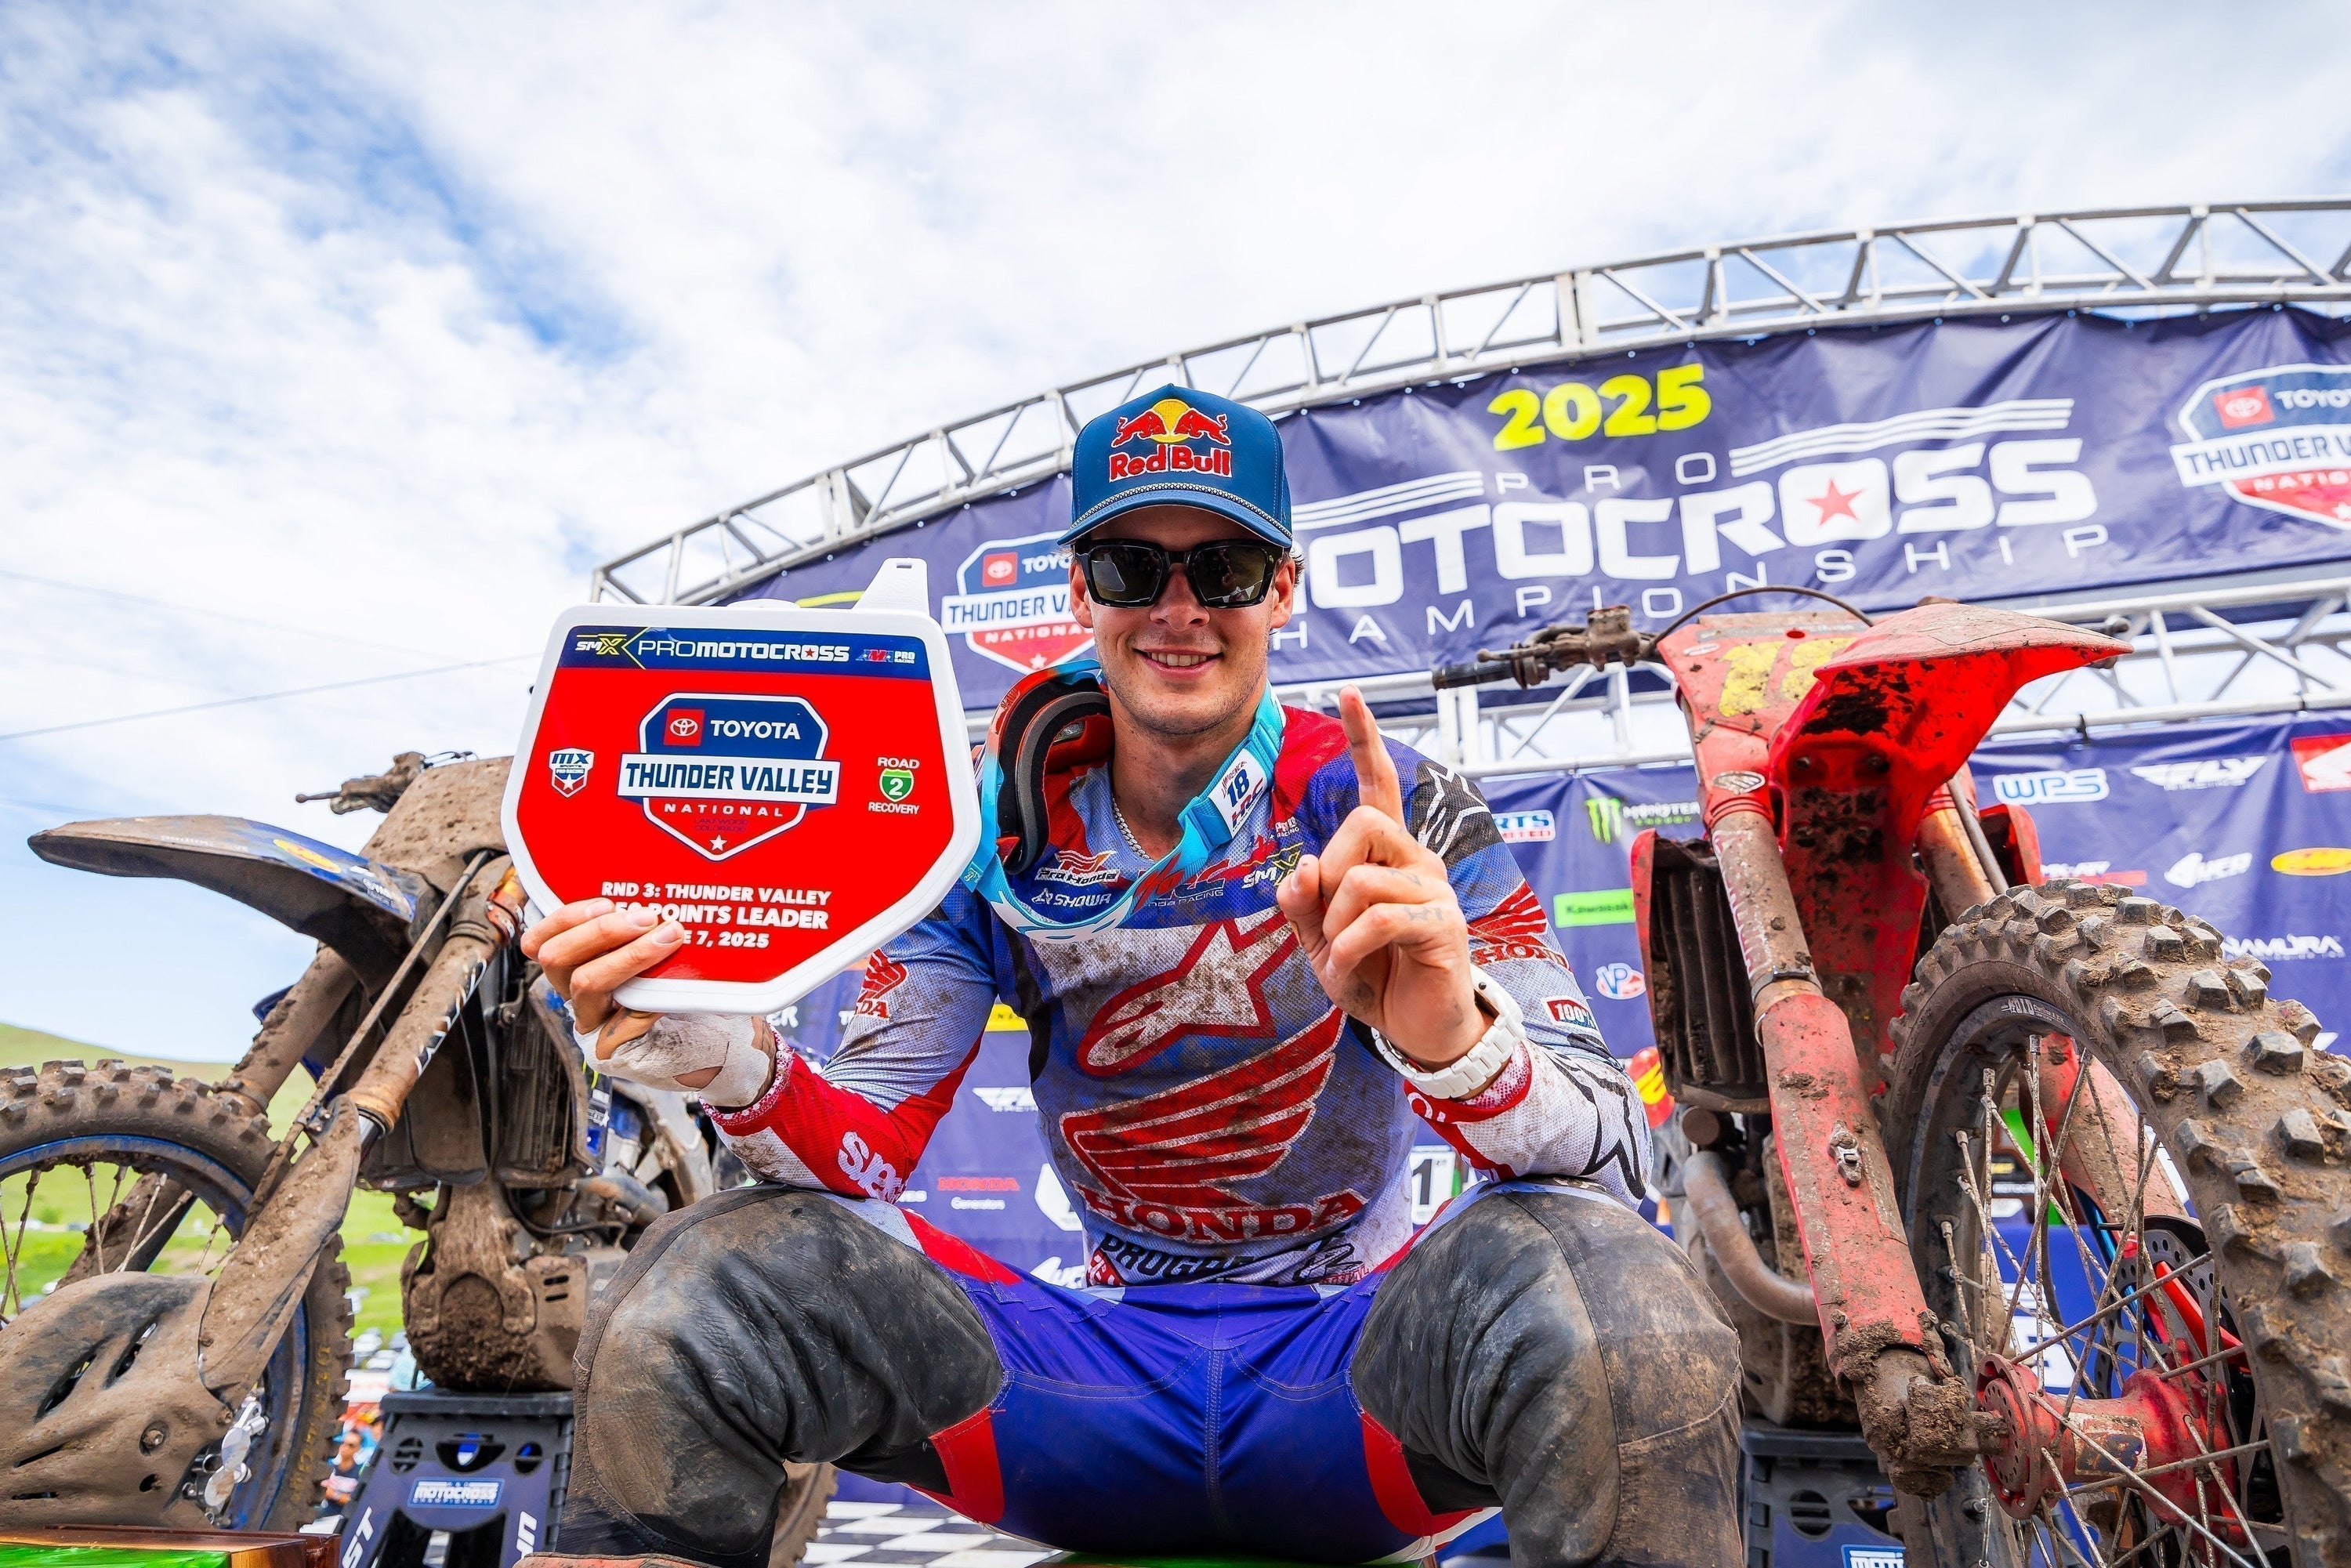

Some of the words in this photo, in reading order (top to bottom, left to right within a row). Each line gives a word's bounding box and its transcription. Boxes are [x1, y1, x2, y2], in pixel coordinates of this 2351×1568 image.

[1487, 363, 1712, 451] 2025
[2274, 388, 2351, 410] TOYO
[1110, 444, 1168, 483] Red
[1170, 444, 1233, 478] Bull
[2183, 436, 2331, 474] THUNDER
[1495, 452, 1716, 494] PRO
[2252, 471, 2351, 493] NATIO
[1021, 551, 1072, 574] TOYO
[1272, 524, 2109, 651] HAMPIONSHIP
[948, 596, 1045, 625] THUNDER
[575, 636, 625, 656] SMX
[637, 639, 849, 663] PROMOTOCROSS
[857, 649, 893, 663] AMA
[894, 650, 915, 660] PRO
[710, 719, 801, 740] TOYOTA
[877, 757, 920, 770] ROAD
[625, 762, 734, 791] THUNDER
[741, 766, 833, 795] VALLEY
[889, 777, 904, 796] 2
[1226, 769, 1250, 808] 18
[2001, 774, 2101, 798] WPS
[664, 802, 784, 817] NATIONAL
[868, 802, 920, 815] RECOVERY
[1232, 777, 1263, 827] HRC
[694, 817, 749, 826] LAKEWOOD
[1277, 827, 1300, 838] RACING
[1493, 813, 1550, 829] RTS
[1038, 868, 1064, 881] Pro
[1066, 870, 1119, 885] Honda
[601, 882, 639, 897] RND
[642, 882, 661, 898] 3:
[665, 883, 755, 902] THUNDER
[758, 887, 832, 906] VALLEY
[1054, 893, 1111, 907] SHOWA
[1178, 890, 1224, 903] RACING
[648, 902, 732, 925] POINTS
[736, 907, 830, 930] LEADER
[696, 930, 714, 947] 7,
[718, 930, 770, 948] 2025
[1470, 943, 1573, 972] HOND
[1601, 967, 1628, 994] VP
[1554, 1002, 1597, 1030] 100%
[938, 1176, 1020, 1192] HONDA
[1072, 1181, 1371, 1244] HONDA
